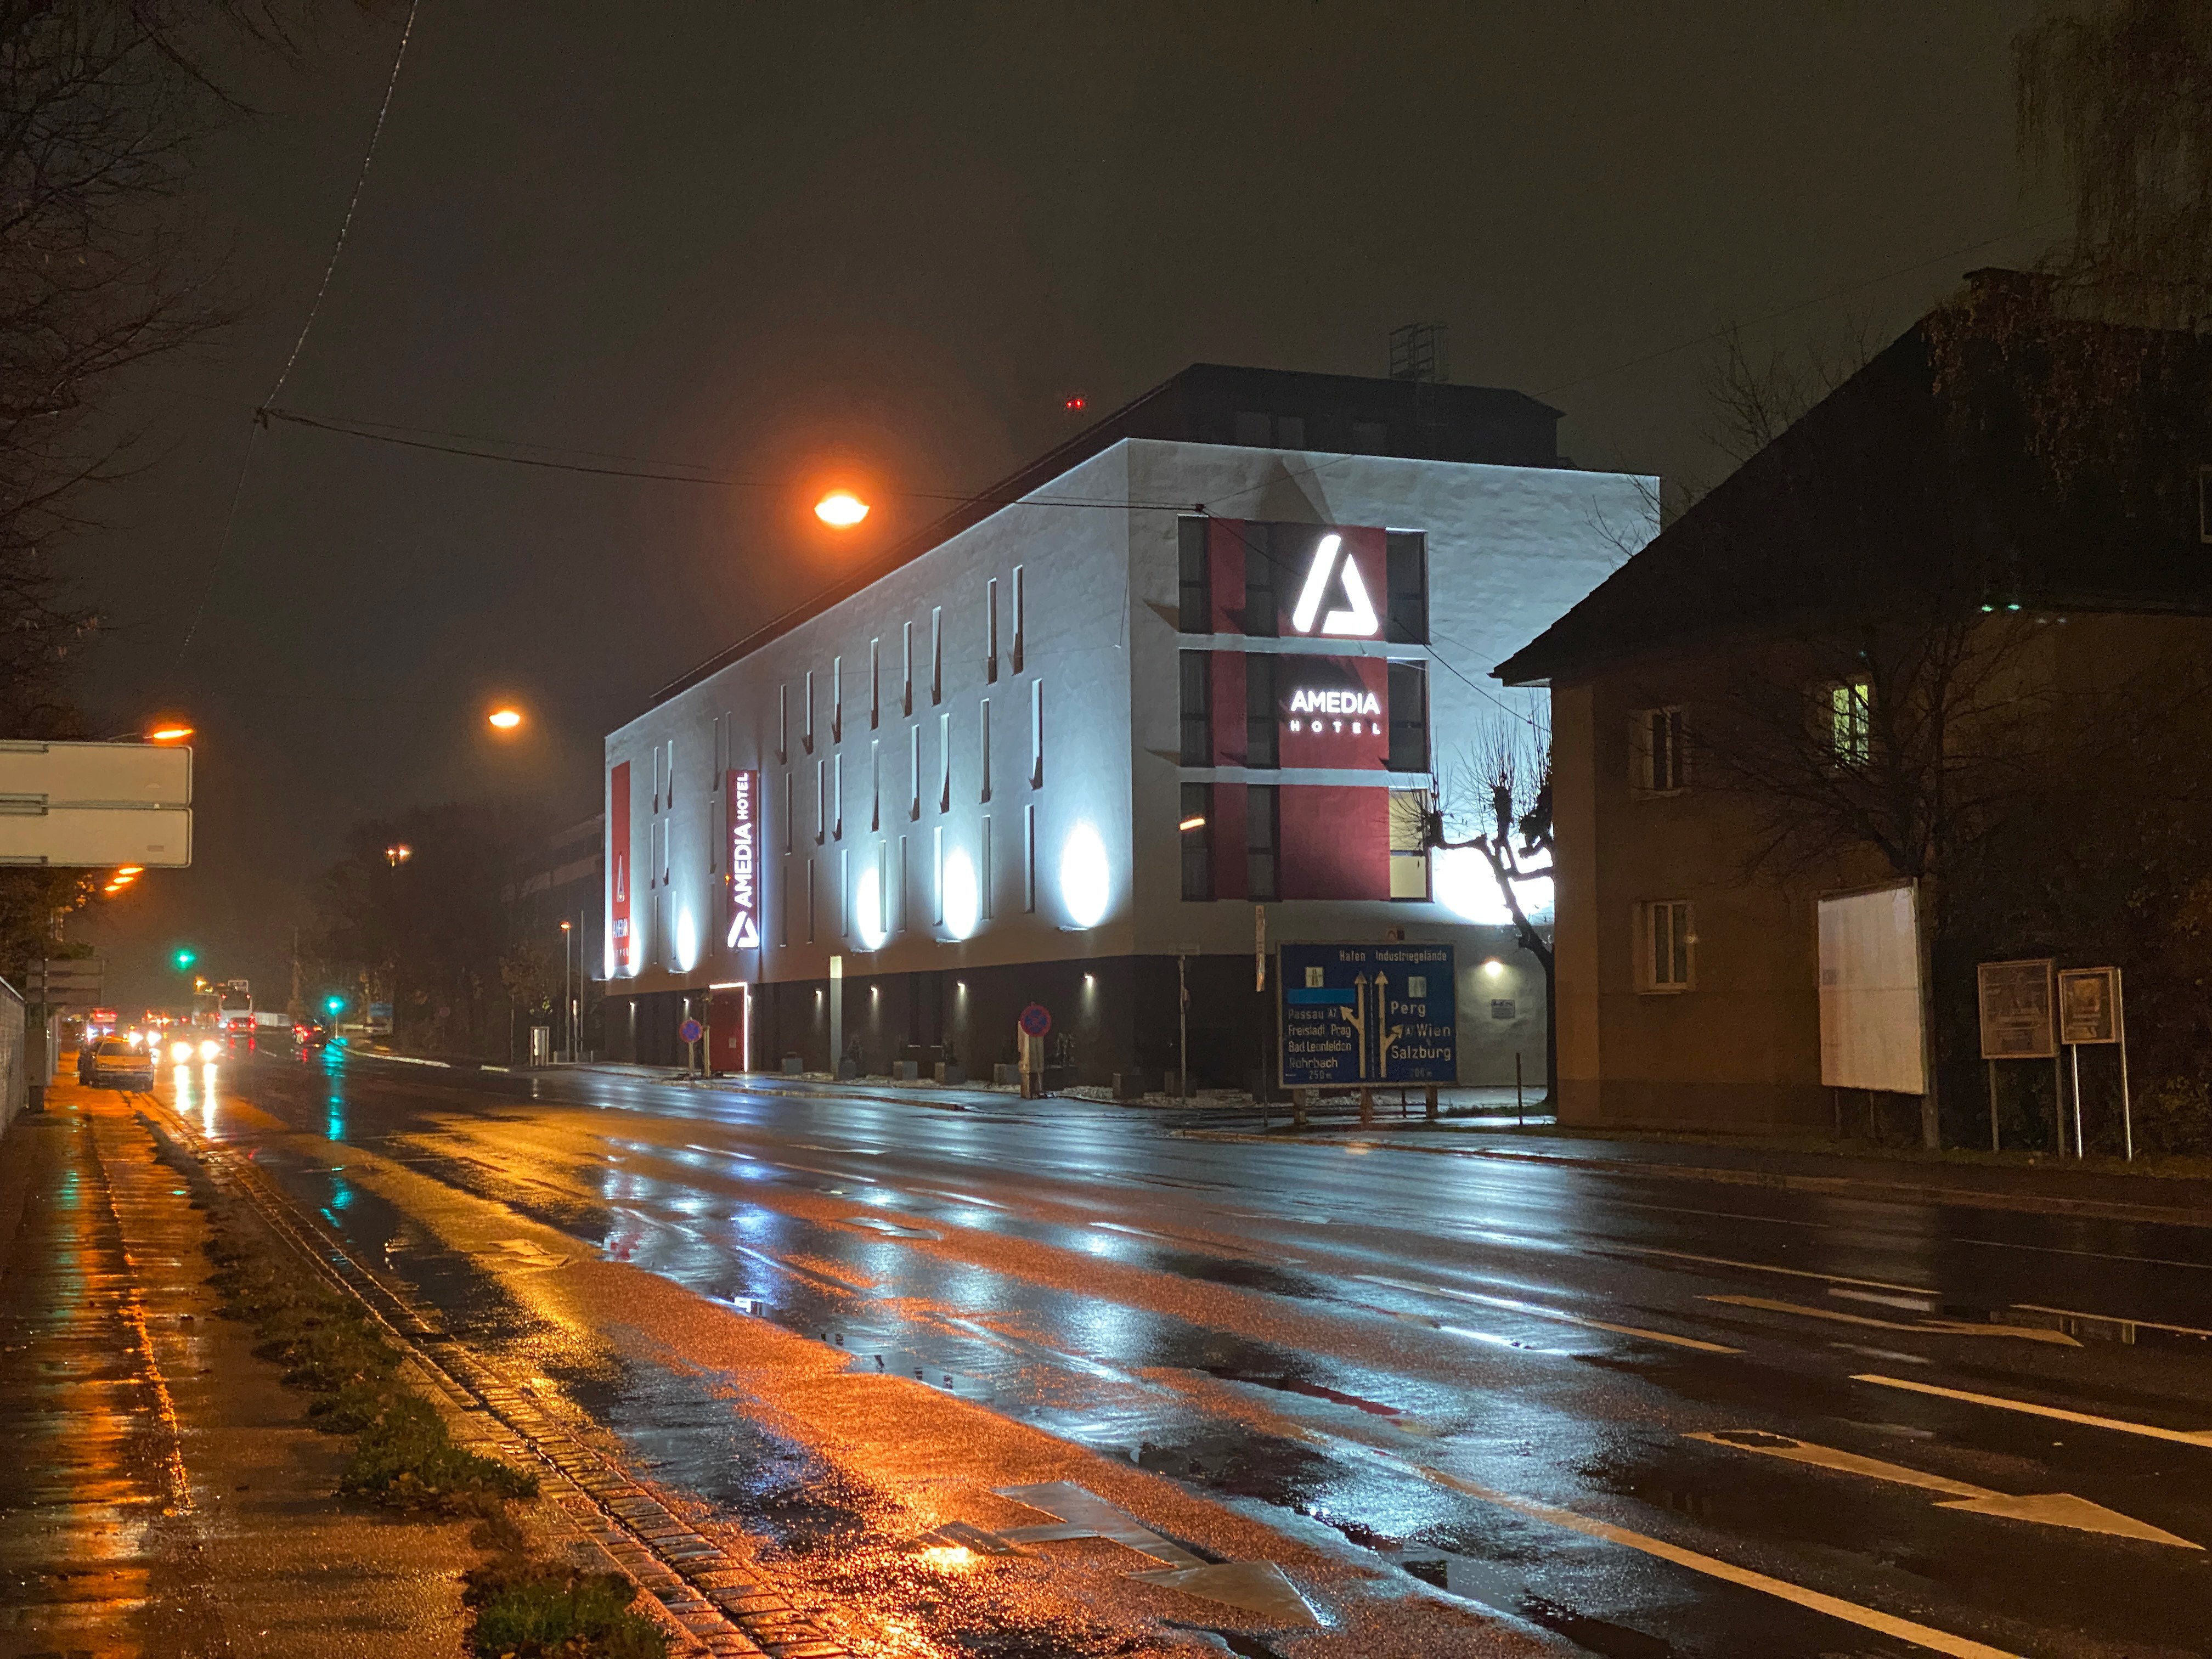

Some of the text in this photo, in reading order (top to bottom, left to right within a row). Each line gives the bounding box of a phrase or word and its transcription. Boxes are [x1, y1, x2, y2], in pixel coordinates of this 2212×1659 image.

[1290, 689, 1381, 715] AMEDIA
[1290, 719, 1381, 735] HOTEL
[737, 772, 748, 820] HOTEL
[733, 822, 753, 909] AMEDIA
[1340, 950, 1447, 964] Hafen Industriegelände
[1288, 1008, 1324, 1020] Passau
[1391, 1001, 1426, 1017] Perg
[1288, 1024, 1352, 1037] Freistadt Prag
[1416, 1023, 1451, 1037] Wien
[1289, 1041, 1305, 1052] Bad
[1391, 1046, 1452, 1062] Salzburg
[1289, 1056, 1339, 1068] Rohrbach
